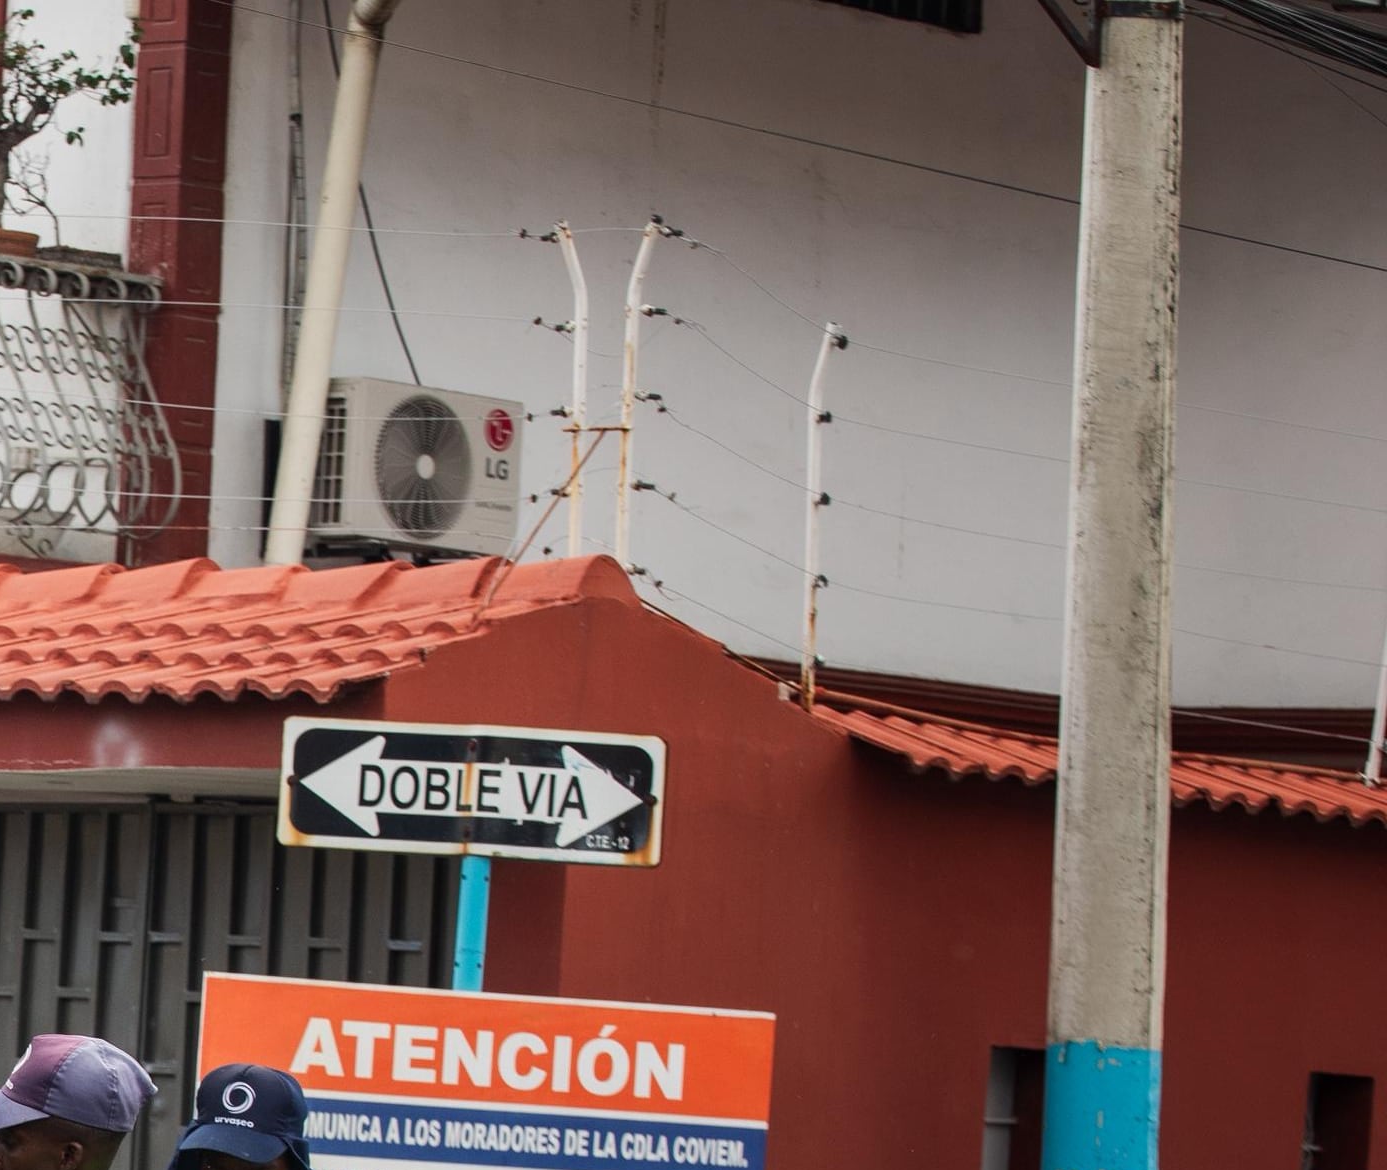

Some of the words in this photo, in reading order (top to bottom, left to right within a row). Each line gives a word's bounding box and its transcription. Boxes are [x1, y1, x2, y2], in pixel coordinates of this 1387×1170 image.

[485, 457, 509, 480] LG
[358, 764, 502, 814] DOBLE
[517, 771, 589, 820] VIA
[290, 1015, 686, 1101] ATENCIÓN
[214, 1116, 255, 1129] urvaseo
[304, 1111, 382, 1143] MUNICA
[386, 1117, 400, 1144] A
[404, 1118, 440, 1147] LOS
[444, 1121, 560, 1156] MORADORES
[564, 1128, 590, 1157] DE
[593, 1131, 618, 1159] LA
[621, 1132, 669, 1163] CDLA
[673, 1136, 748, 1168] COVIEM.
